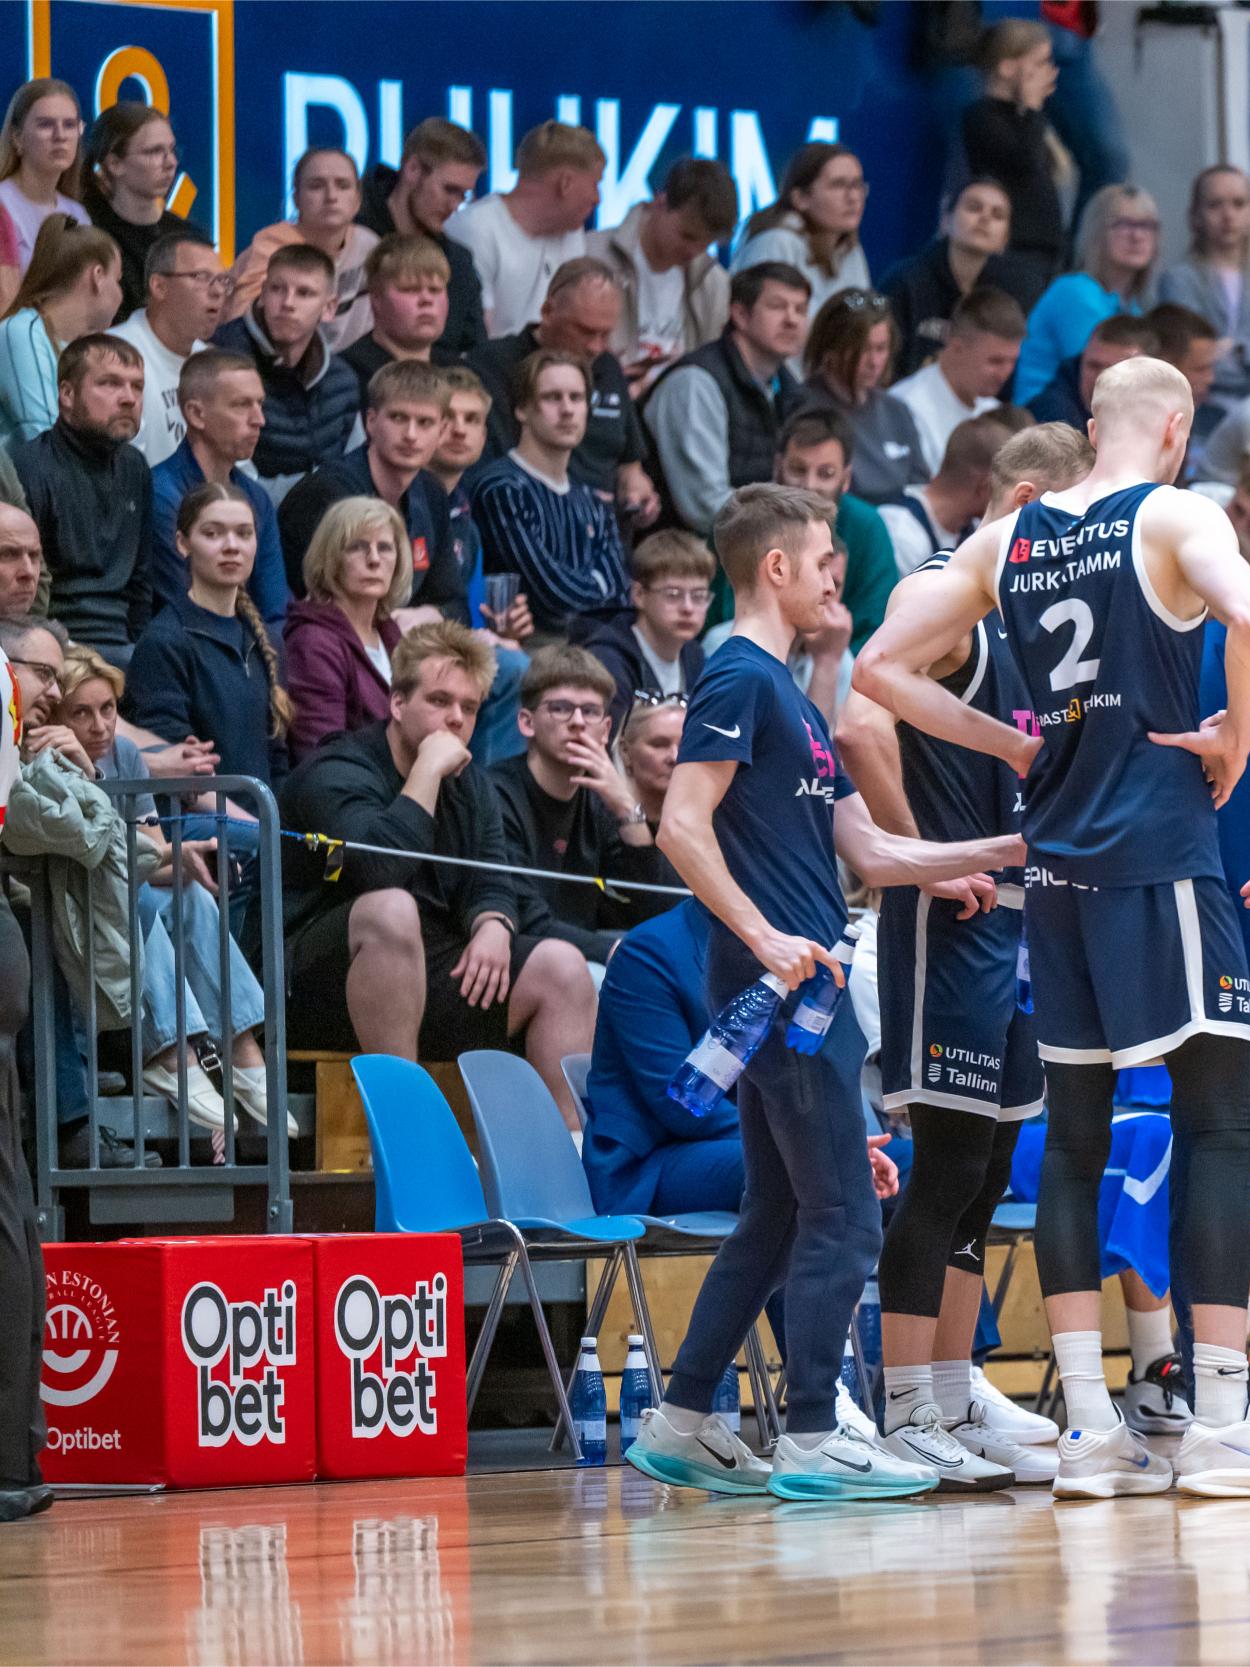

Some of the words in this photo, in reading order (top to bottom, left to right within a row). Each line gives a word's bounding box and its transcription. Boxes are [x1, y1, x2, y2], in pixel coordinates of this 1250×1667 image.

[1009, 550, 1121, 593] JURKTAMM
[1039, 597, 1101, 692] 2
[945, 1046, 1001, 1070] UTILITAS
[946, 1067, 998, 1094] Tallinn
[61, 1270, 121, 1344] ESTONIAN
[183, 1282, 295, 1377] Opti
[336, 1273, 446, 1369] Opti
[200, 1364, 284, 1438] bet
[352, 1357, 436, 1429] bet
[46, 1426, 122, 1456] Optibet
